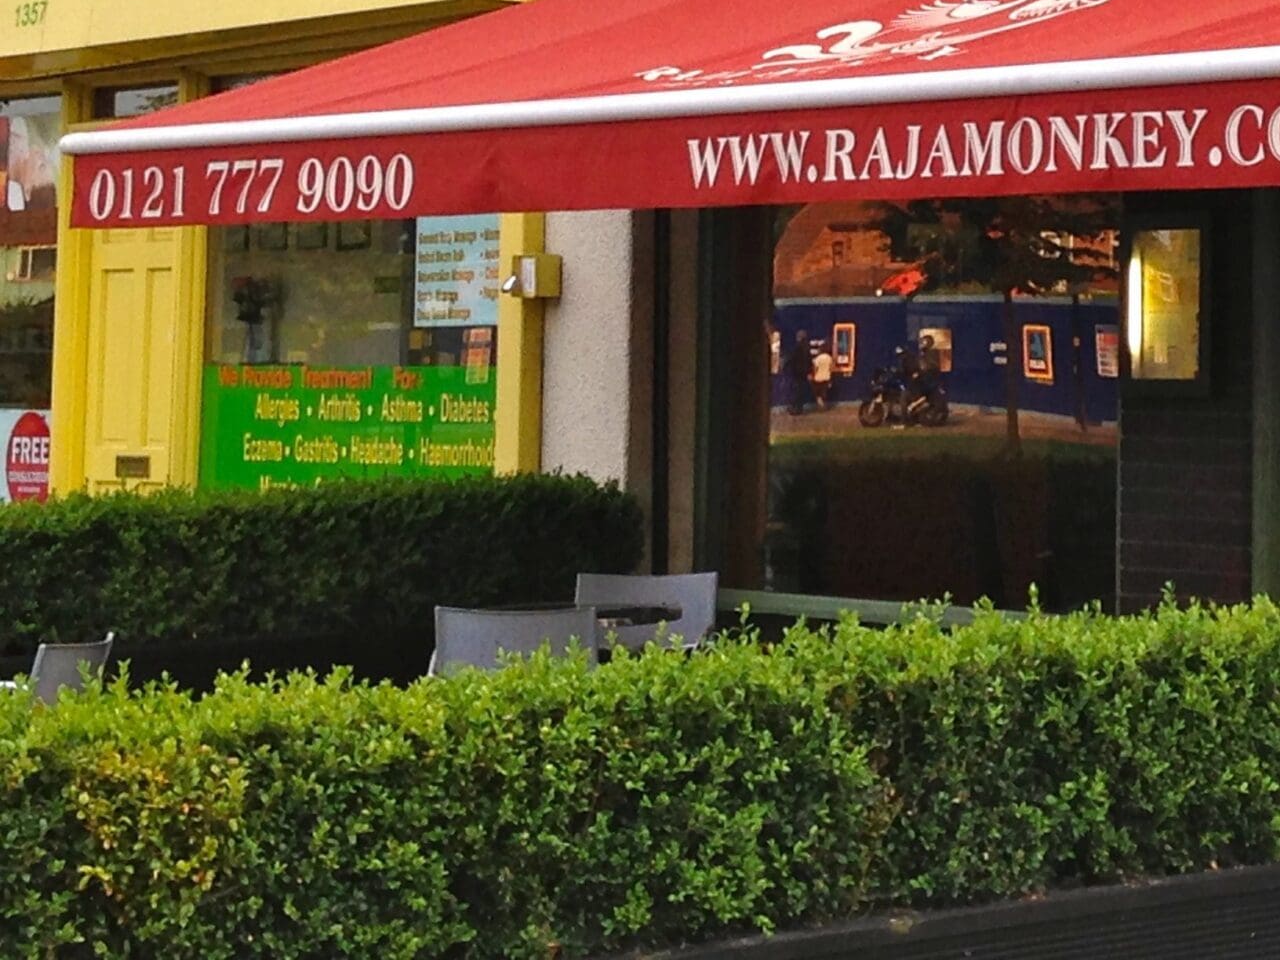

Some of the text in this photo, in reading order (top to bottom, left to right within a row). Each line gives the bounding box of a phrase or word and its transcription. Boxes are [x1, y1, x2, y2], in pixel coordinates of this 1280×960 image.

[15, 0, 49, 28] 1357
[88, 152, 415, 220] 0121 777 9090
[218, 366, 238, 386] We
[242, 366, 293, 388] Provide
[301, 366, 373, 389] Treatment
[255, 393, 490, 428] Allergies Arthritis Asthma Diabetes
[11, 436, 50, 465] FREE
[243, 433, 283, 462] Eczema
[294, 435, 339, 464] Gastritis
[350, 436, 403, 465] Headache
